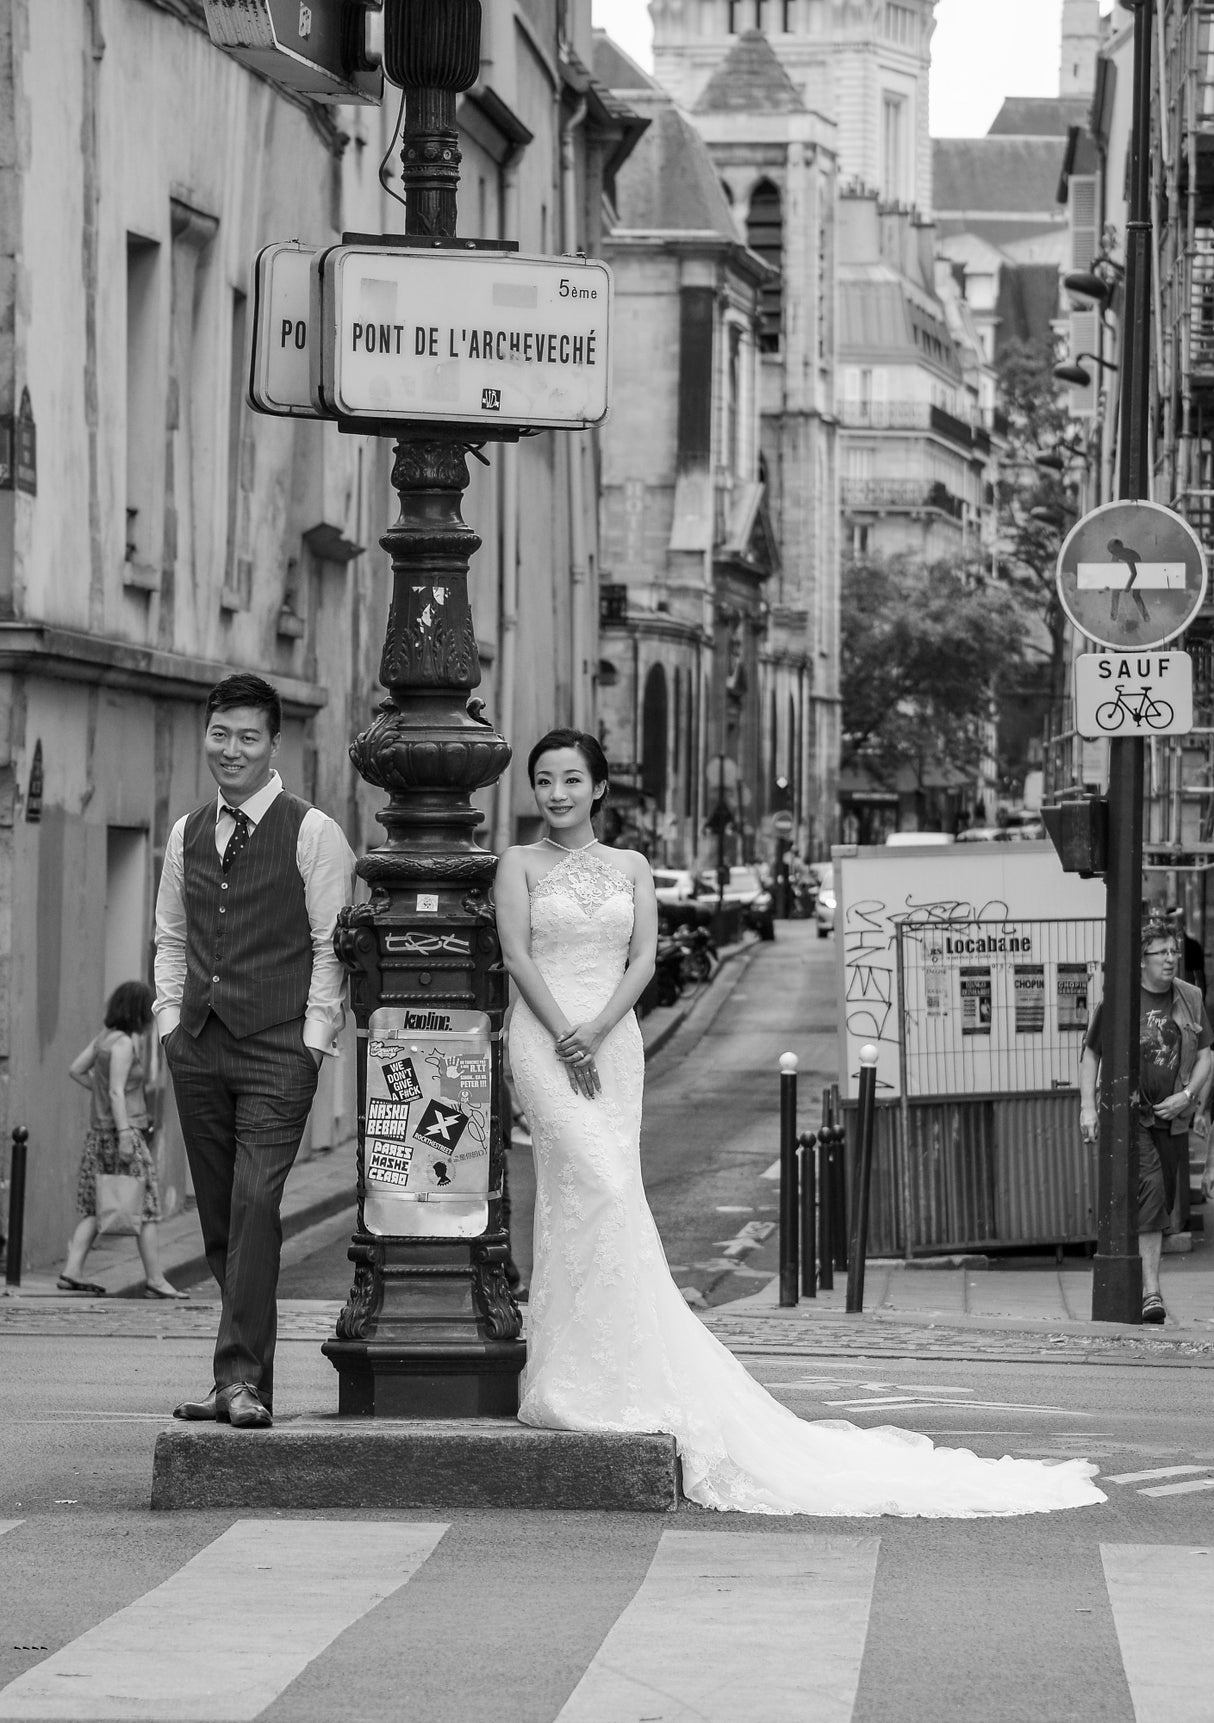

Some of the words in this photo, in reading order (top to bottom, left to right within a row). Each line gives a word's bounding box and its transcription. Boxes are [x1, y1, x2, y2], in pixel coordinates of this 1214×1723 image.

[559, 279, 597, 299] 5ème
[281, 319, 307, 350] PO
[352, 322, 404, 355] PONT
[415, 326, 439, 357] DE
[450, 329, 596, 365] L'ARCHEVECHÉ
[1098, 658, 1170, 679] SAUF
[946, 935, 1031, 954] Locabane
[1014, 979, 1044, 989] CHOPIN
[389, 1061, 405, 1073] WE
[386, 1068, 412, 1084] DON'T
[393, 1077, 413, 1092] GIVE
[392, 1092, 399, 1101] A
[369, 1104, 409, 1120] NASKO
[367, 1120, 407, 1135] BEBAR
[371, 1154, 409, 1172] MASHE
